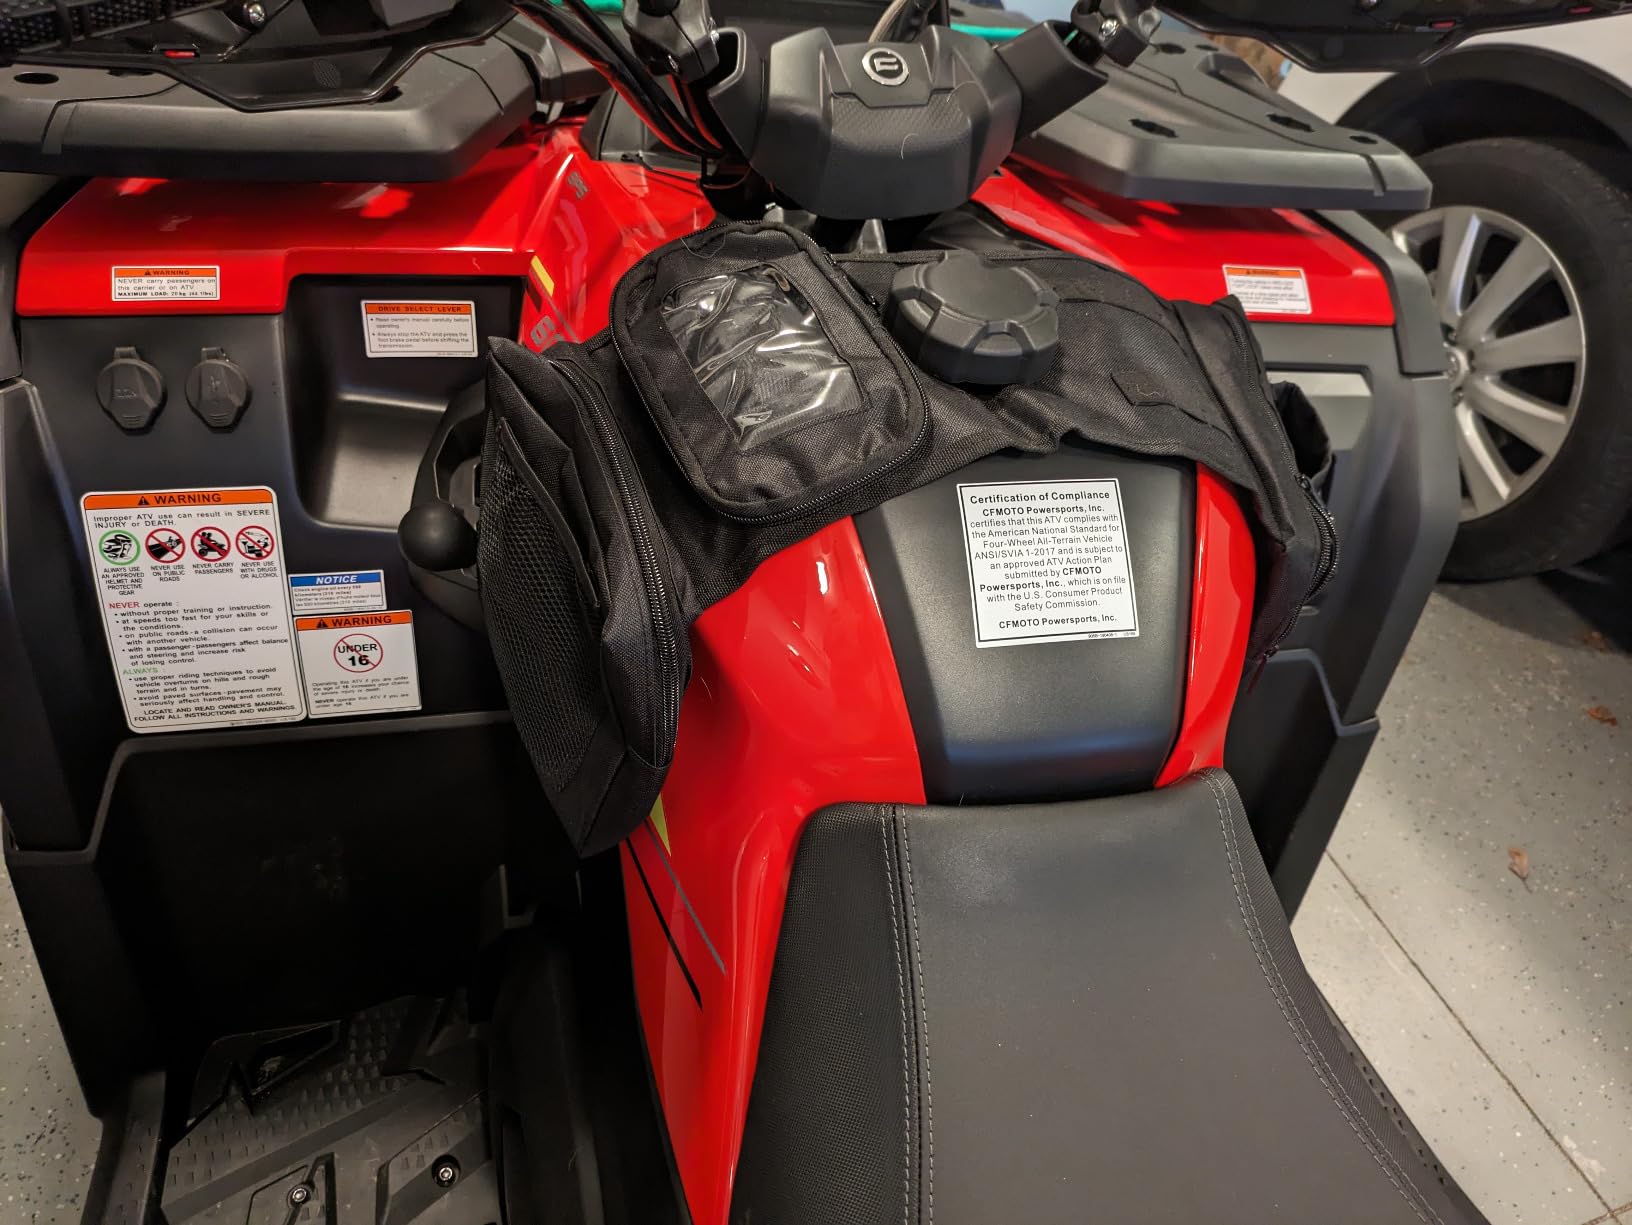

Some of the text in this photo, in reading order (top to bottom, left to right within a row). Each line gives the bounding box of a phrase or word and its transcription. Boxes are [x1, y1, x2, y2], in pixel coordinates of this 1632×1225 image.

[154, 493, 221, 505] WARNING
[970, 491, 1110, 504] Certification of Compliance
[982, 504, 1104, 517] CFMOTO Powersports, Inc.
[970, 514, 1118, 528] certifies that this ATV complies with
[971, 524, 1119, 539] the American National Standard for
[983, 535, 1113, 548] Four-Wheel All-Terrain Vehicle
[974, 549, 1024, 560] ANSI/SVIA
[1026, 547, 1055, 556] 1-2017
[1058, 546, 1074, 555] and
[1084, 545, 1114, 555] subject
[1003, 559, 1045, 570] approved
[1046, 557, 1064, 566] ATV
[1066, 557, 1092, 565] Action
[1094, 555, 1112, 564] Plan
[1004, 566, 1102, 580] submitted by CFMOTO
[316, 575, 357, 585] NOTICE
[980, 581, 1044, 592] Powersports,
[1045, 580, 1066, 588] Inc.,
[1068, 578, 1092, 586] which
[1114, 576, 1126, 584] file
[986, 587, 1122, 602] with the U.S. Consumer Product
[109, 601, 140, 609] NEVER
[1014, 598, 1100, 612] Safety Commission.
[331, 615, 392, 627] WARNING
[999, 614, 1117, 629] CFMOTO Powersports, Inc.
[336, 643, 378, 653] UNDER
[348, 654, 370, 666] 16
[123, 667, 158, 675] ALWAYS
[184, 710, 237, 718] INSTRUCTIONS
